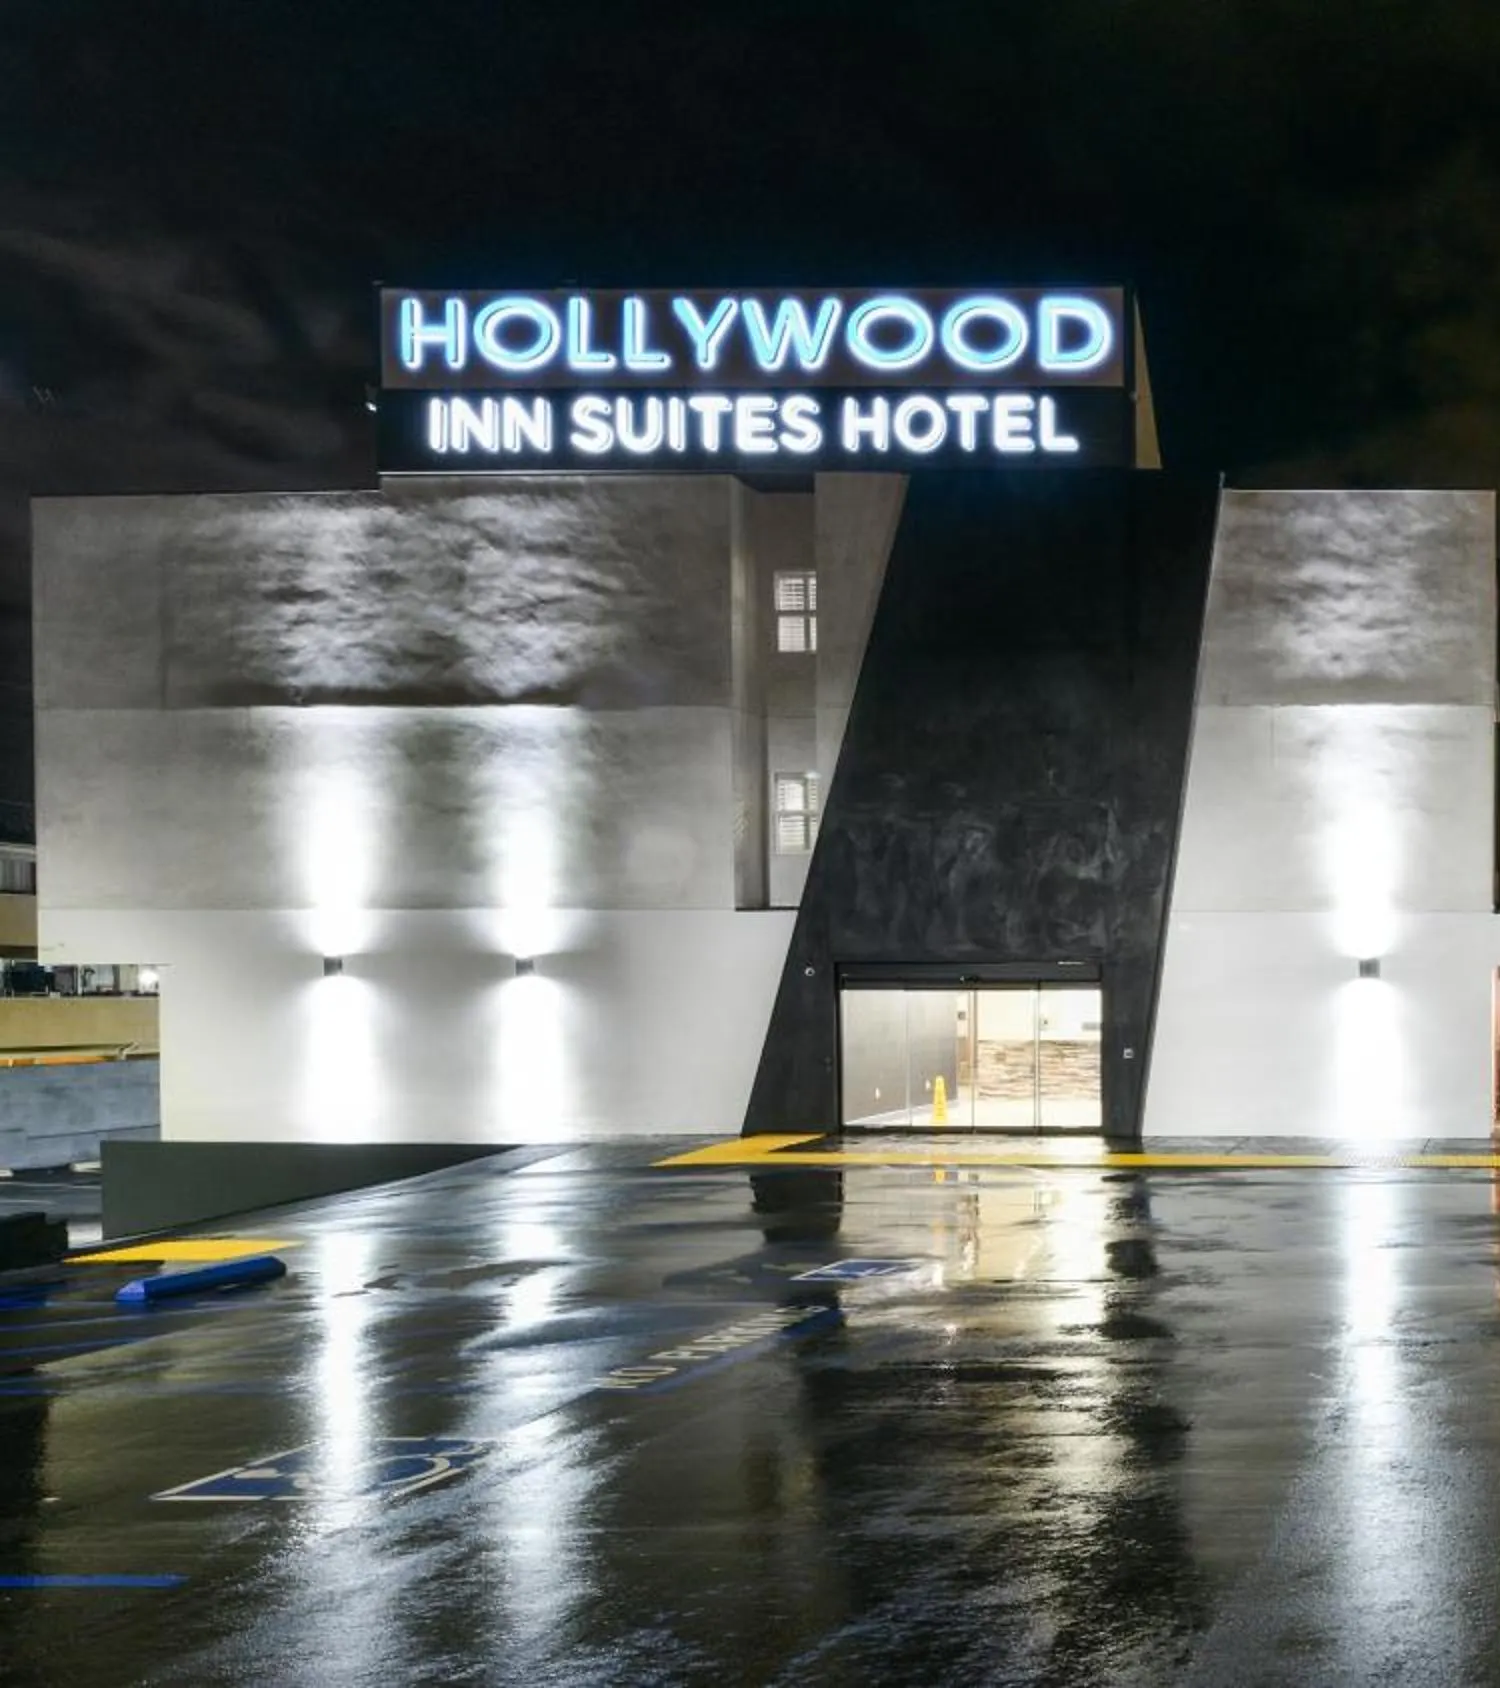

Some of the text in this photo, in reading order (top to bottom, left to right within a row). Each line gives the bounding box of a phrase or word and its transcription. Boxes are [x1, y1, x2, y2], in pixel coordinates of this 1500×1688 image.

[400, 296, 1113, 370] HOLLYWOOD
[429, 396, 1080, 452] INN SUITES HOTEL
[592, 1364, 678, 1389] NO
